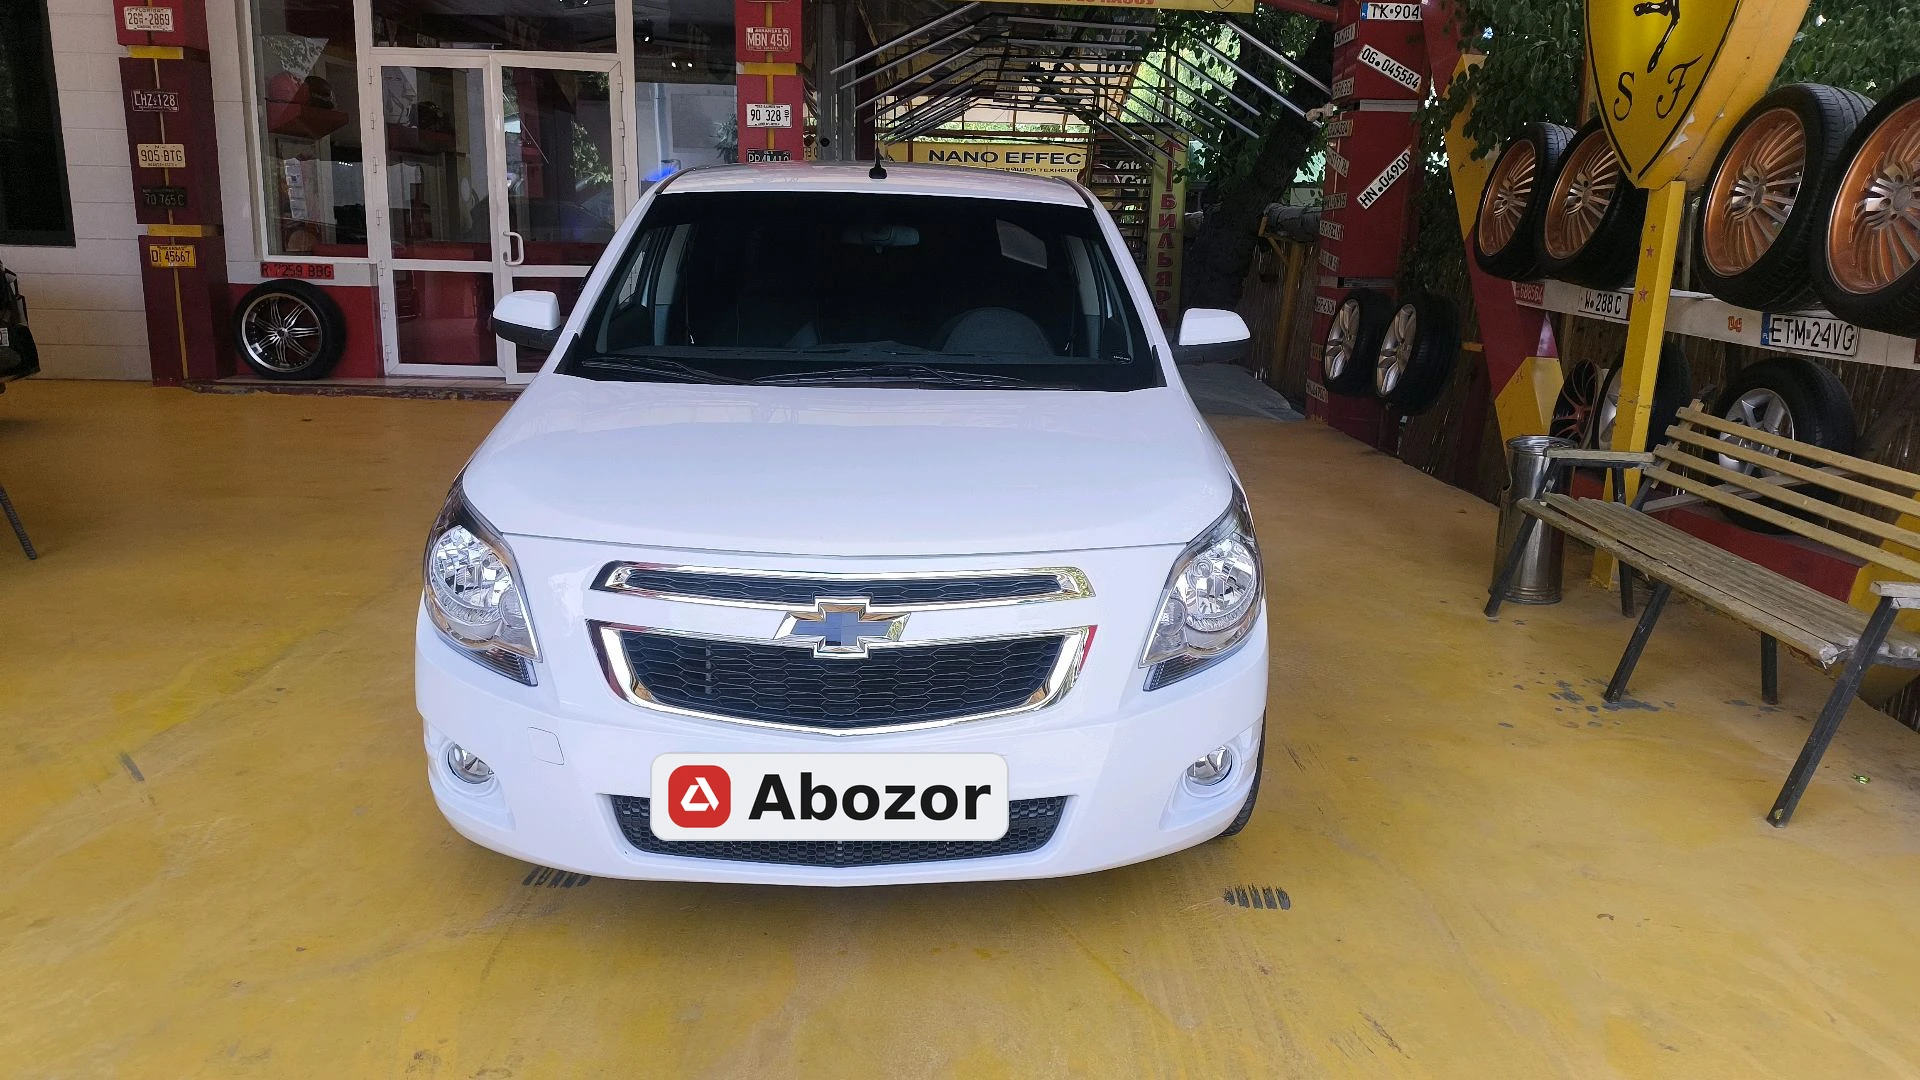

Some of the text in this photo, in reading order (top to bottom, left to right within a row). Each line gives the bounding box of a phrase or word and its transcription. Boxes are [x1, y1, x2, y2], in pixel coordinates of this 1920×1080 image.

[747, 33, 789, 47] MBN 450
[750, 109, 781, 121] 90 328
[929, 150, 999, 163] NANO
[164, 250, 190, 262] 45667
